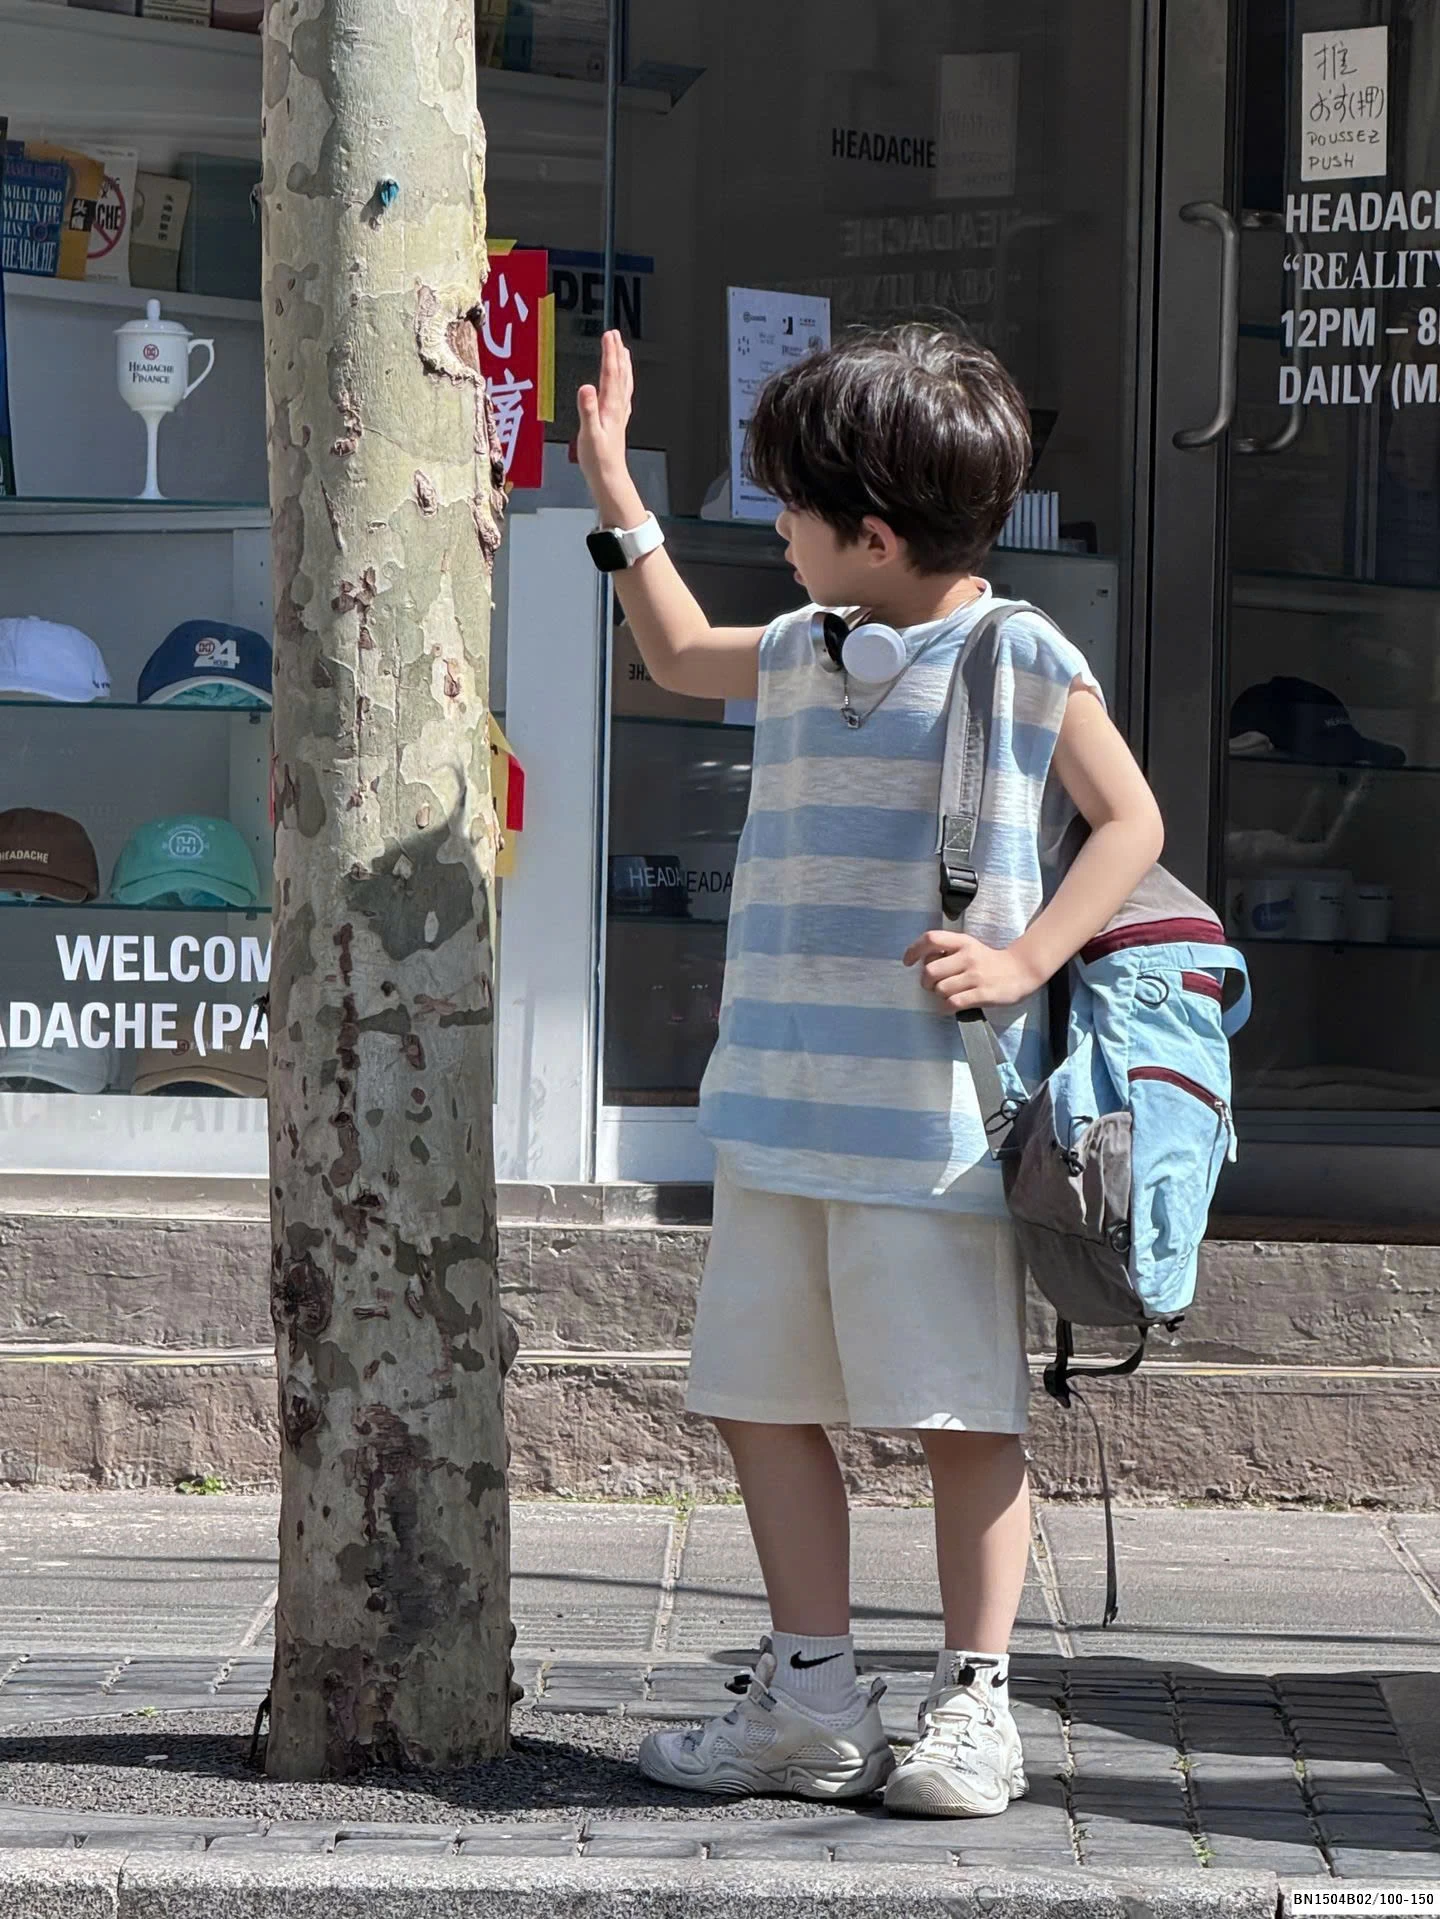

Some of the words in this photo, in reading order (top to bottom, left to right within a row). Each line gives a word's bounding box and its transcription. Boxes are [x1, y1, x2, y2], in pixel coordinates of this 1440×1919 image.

[1314, 40, 1357, 80] 推
[831, 128, 936, 168] HEADACHE
[1307, 130, 1380, 146] POUSSEZ
[1308, 152, 1354, 170] PUSH
[3, 183, 33, 200] WHAT
[35, 187, 47, 203] TO
[48, 188, 62, 203] DO
[3, 199, 47, 223] WHEN
[1286, 189, 1440, 233] HEADAC
[2, 240, 56, 273] HEADACHE
[1283, 249, 1440, 289] “REALIT
[1281, 307, 1376, 347] 12PM
[1417, 306, 1440, 346] 8
[129, 361, 174, 373] HEADACHE
[132, 373, 170, 384] FINANCE
[1279, 364, 1381, 405] DAILY
[1391, 362, 1440, 410] (M
[0, 1001, 178, 1049] DACHE
